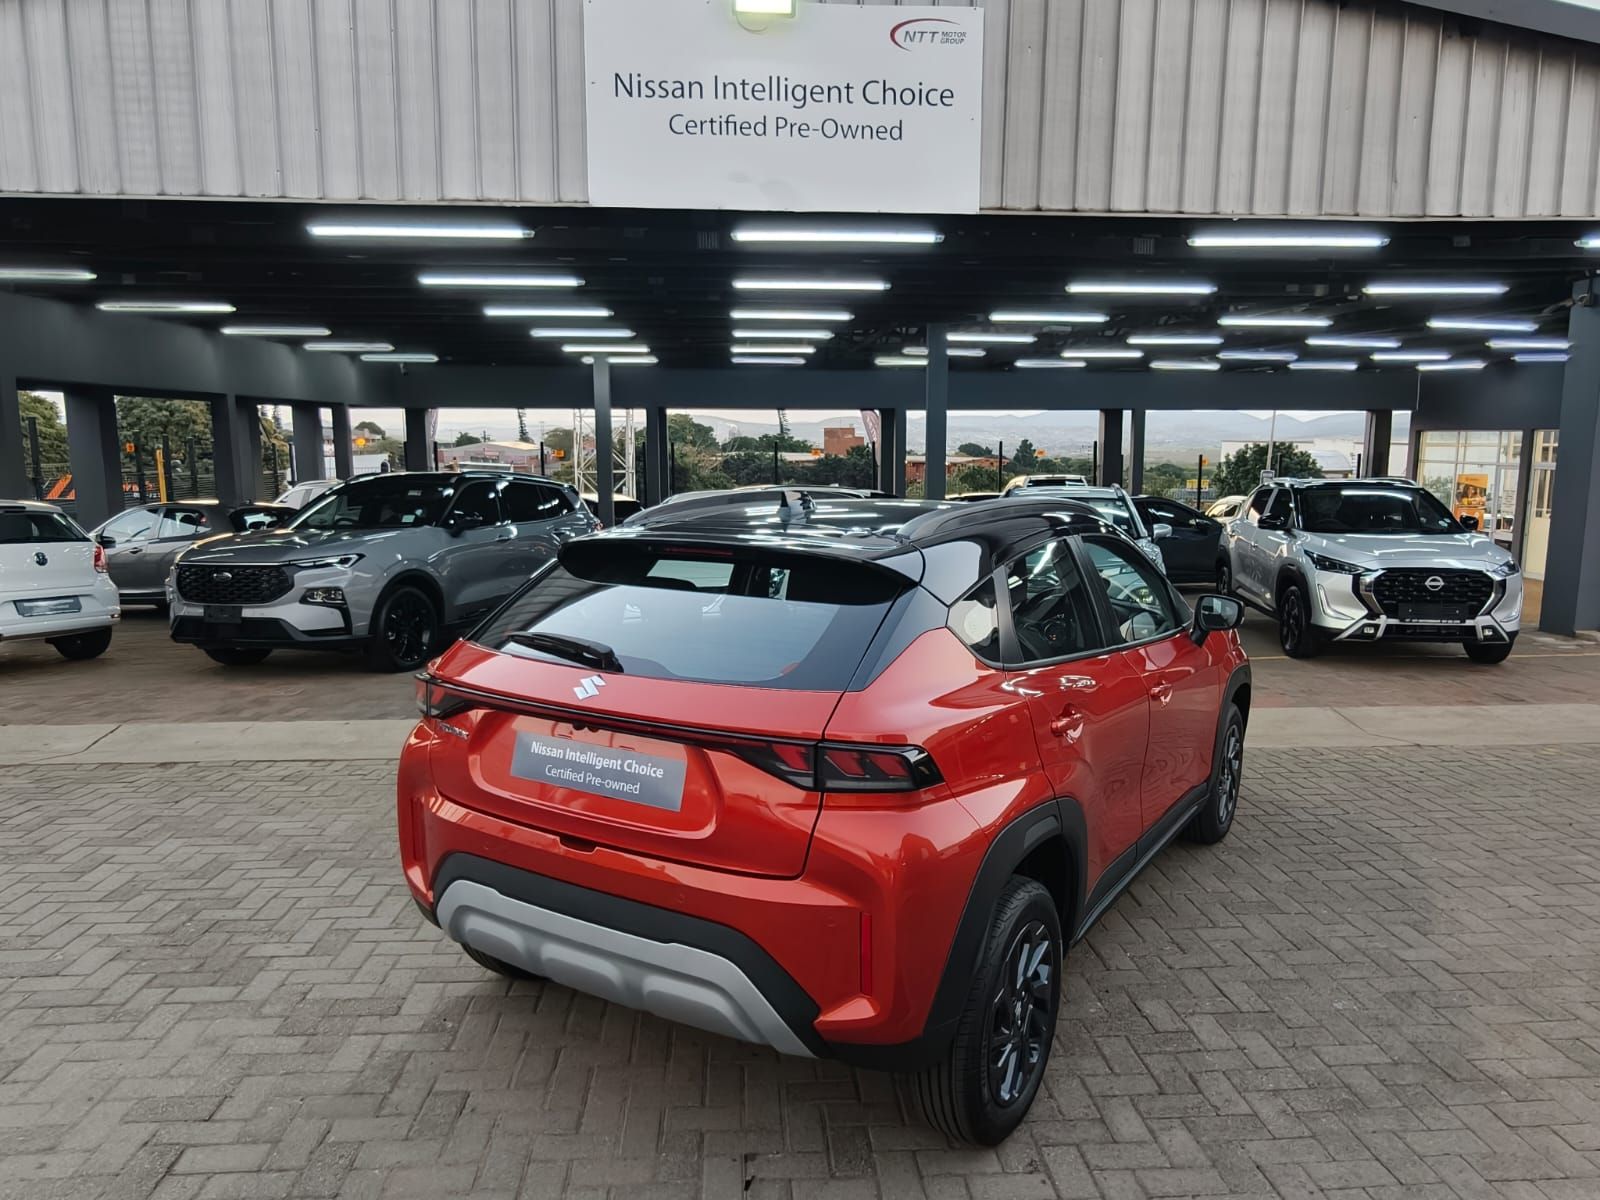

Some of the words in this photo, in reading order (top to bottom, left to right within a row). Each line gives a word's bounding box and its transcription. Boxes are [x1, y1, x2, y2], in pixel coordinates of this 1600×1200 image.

[903, 30, 940, 44] NTT
[613, 72, 704, 99] Nissan
[713, 75, 855, 109] Intelligent
[861, 79, 955, 107] Choice
[668, 113, 767, 137] Certified
[775, 116, 904, 141] Pre-Owned
[531, 741, 564, 760] Nissan
[565, 747, 621, 770] Intelligent
[624, 759, 665, 778] Choice
[545, 764, 585, 783] Certified
[586, 772, 641, 794] Pre-owned
